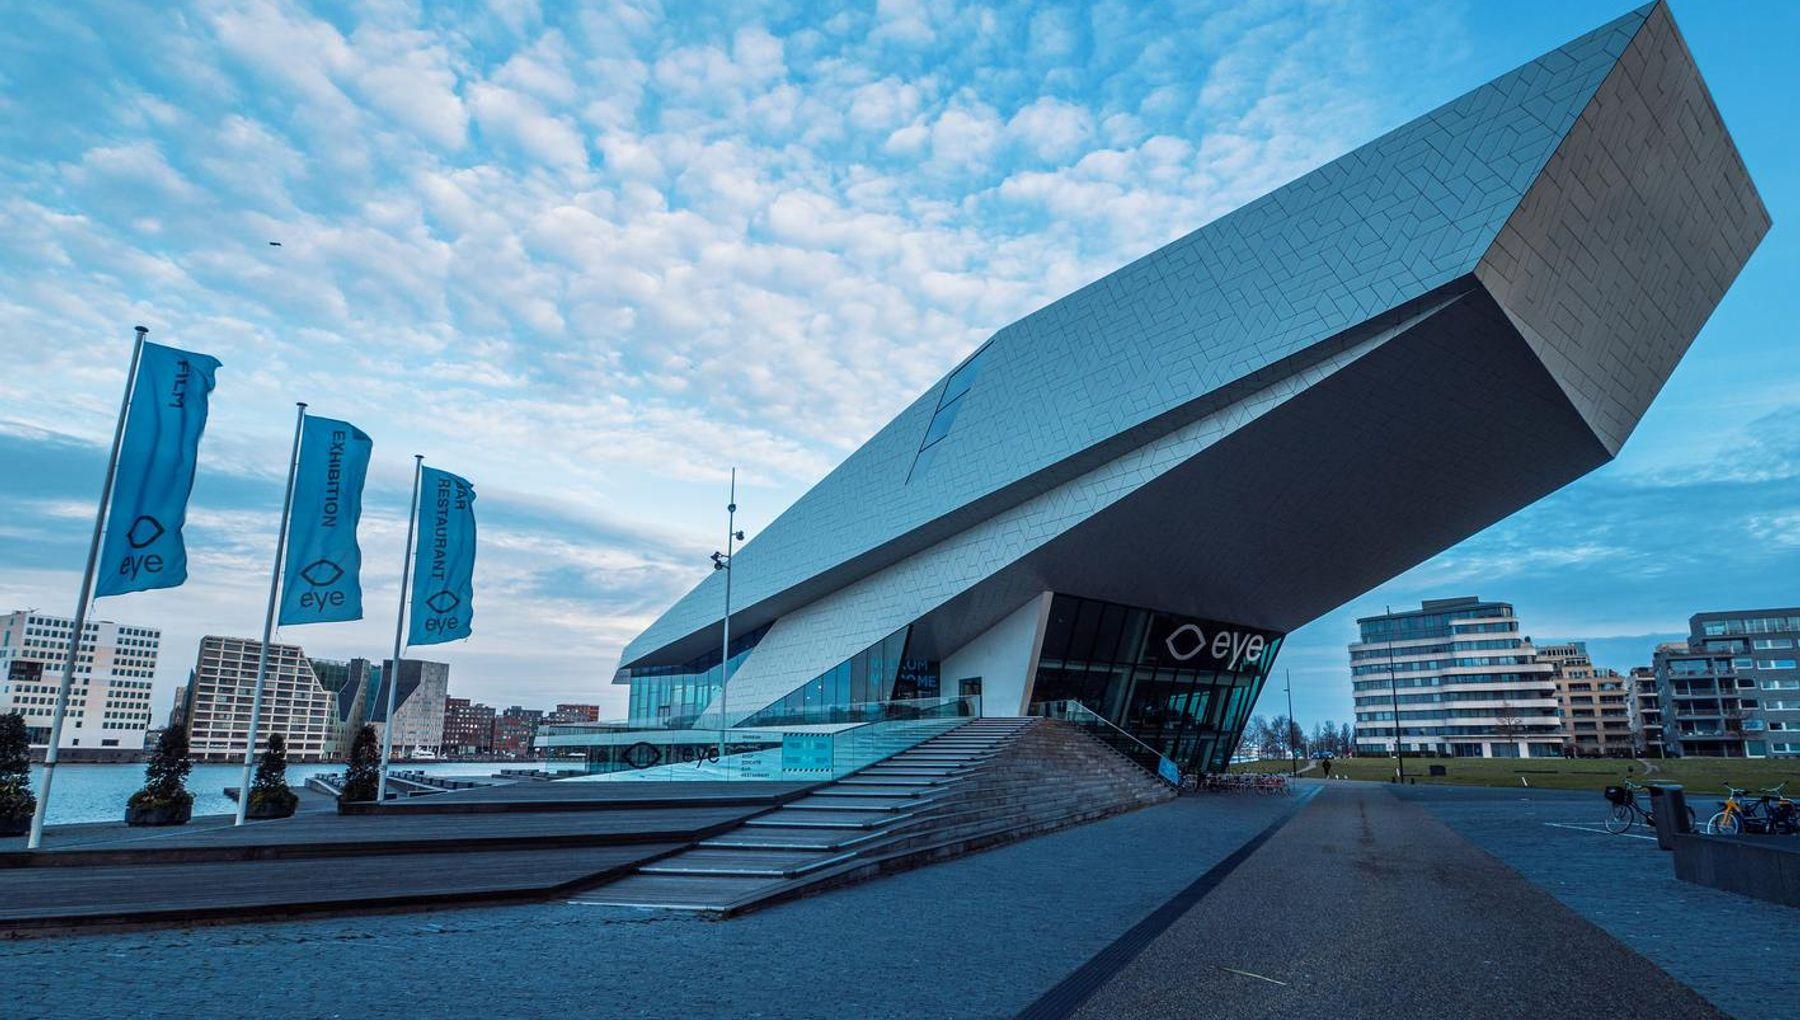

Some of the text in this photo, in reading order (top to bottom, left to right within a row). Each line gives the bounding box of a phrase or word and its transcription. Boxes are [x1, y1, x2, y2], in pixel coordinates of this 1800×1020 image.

[168, 360, 190, 408] FILM
[321, 430, 346, 528] EXHIBITION
[431, 478, 451, 582] RESTAURANT
[119, 554, 164, 581] eye
[300, 591, 345, 613] eye
[425, 616, 459, 636] eye
[1211, 630, 1265, 671] eye
[683, 746, 720, 769] eye
